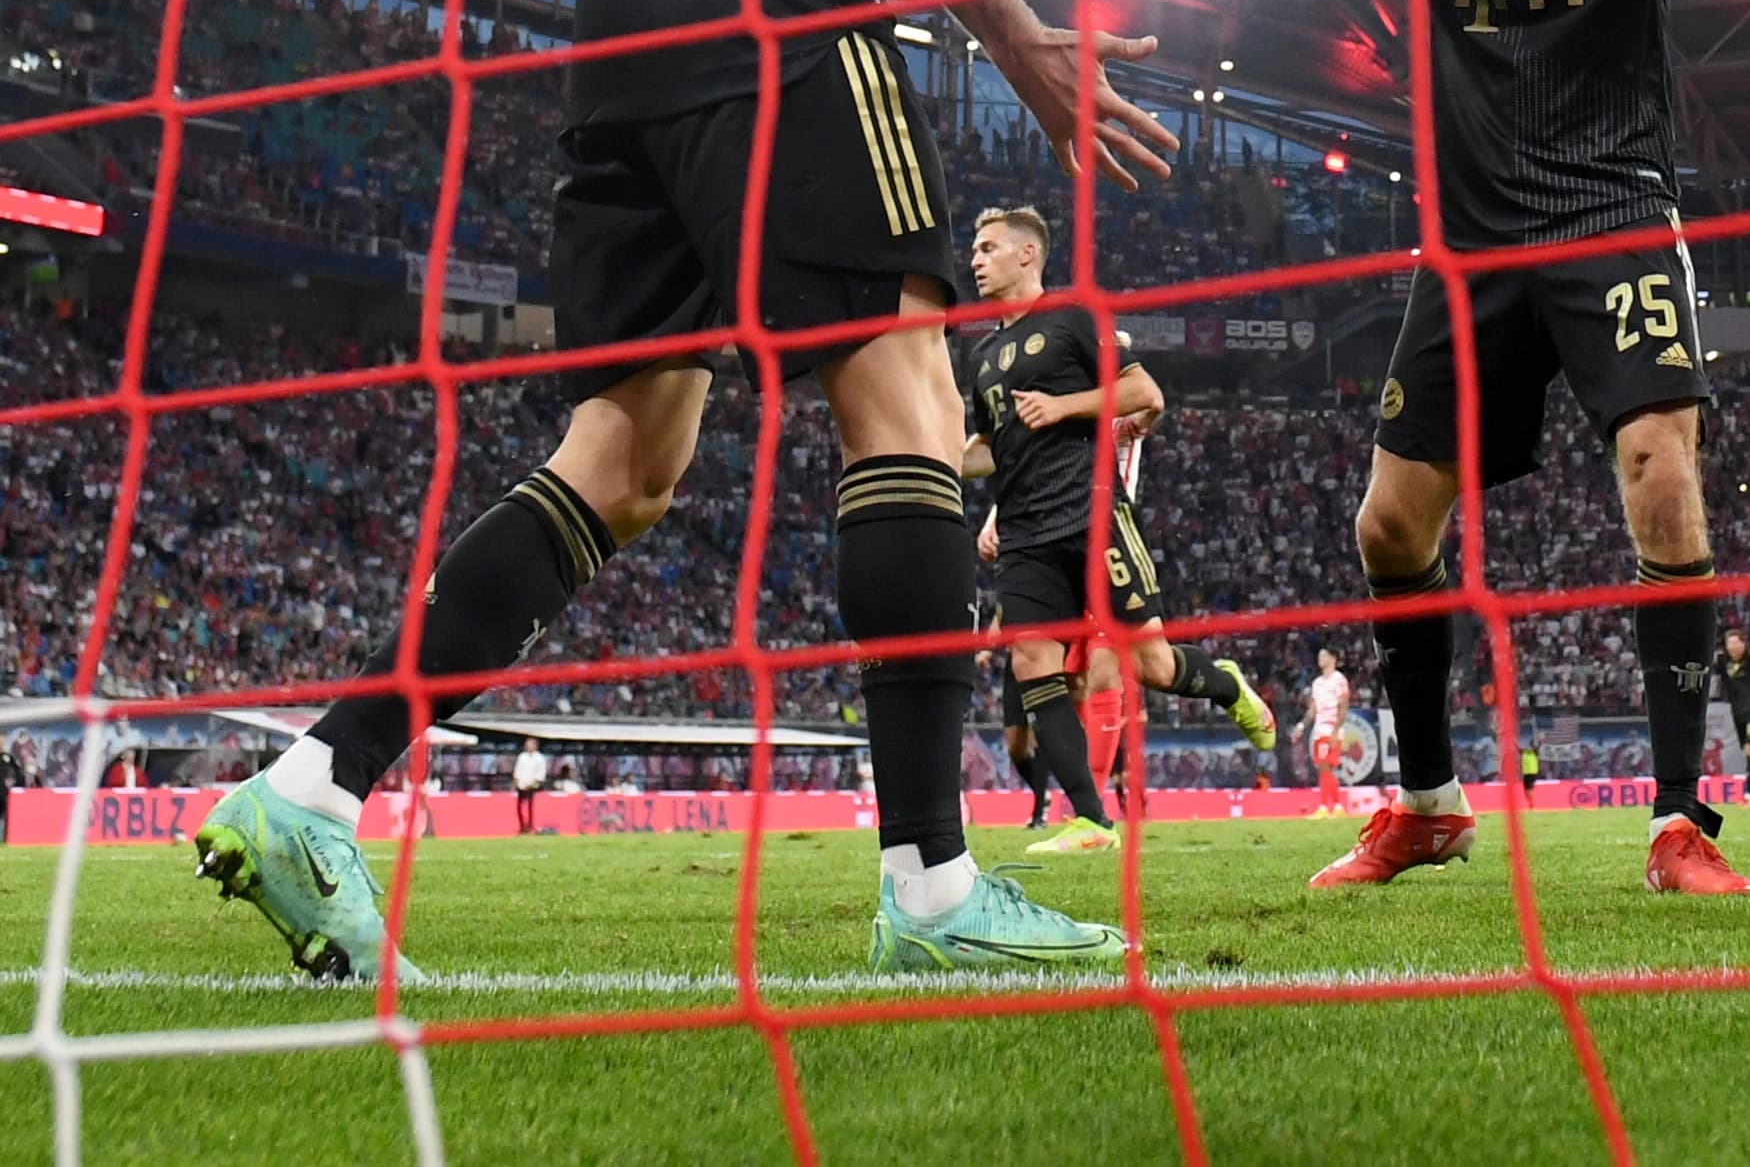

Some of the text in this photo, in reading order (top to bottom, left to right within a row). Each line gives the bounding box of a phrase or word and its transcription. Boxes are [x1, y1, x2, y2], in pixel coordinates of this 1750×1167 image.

[1606, 274, 1678, 352] 25
[1104, 547, 1132, 587] 6
[673, 799, 729, 833] LENA
